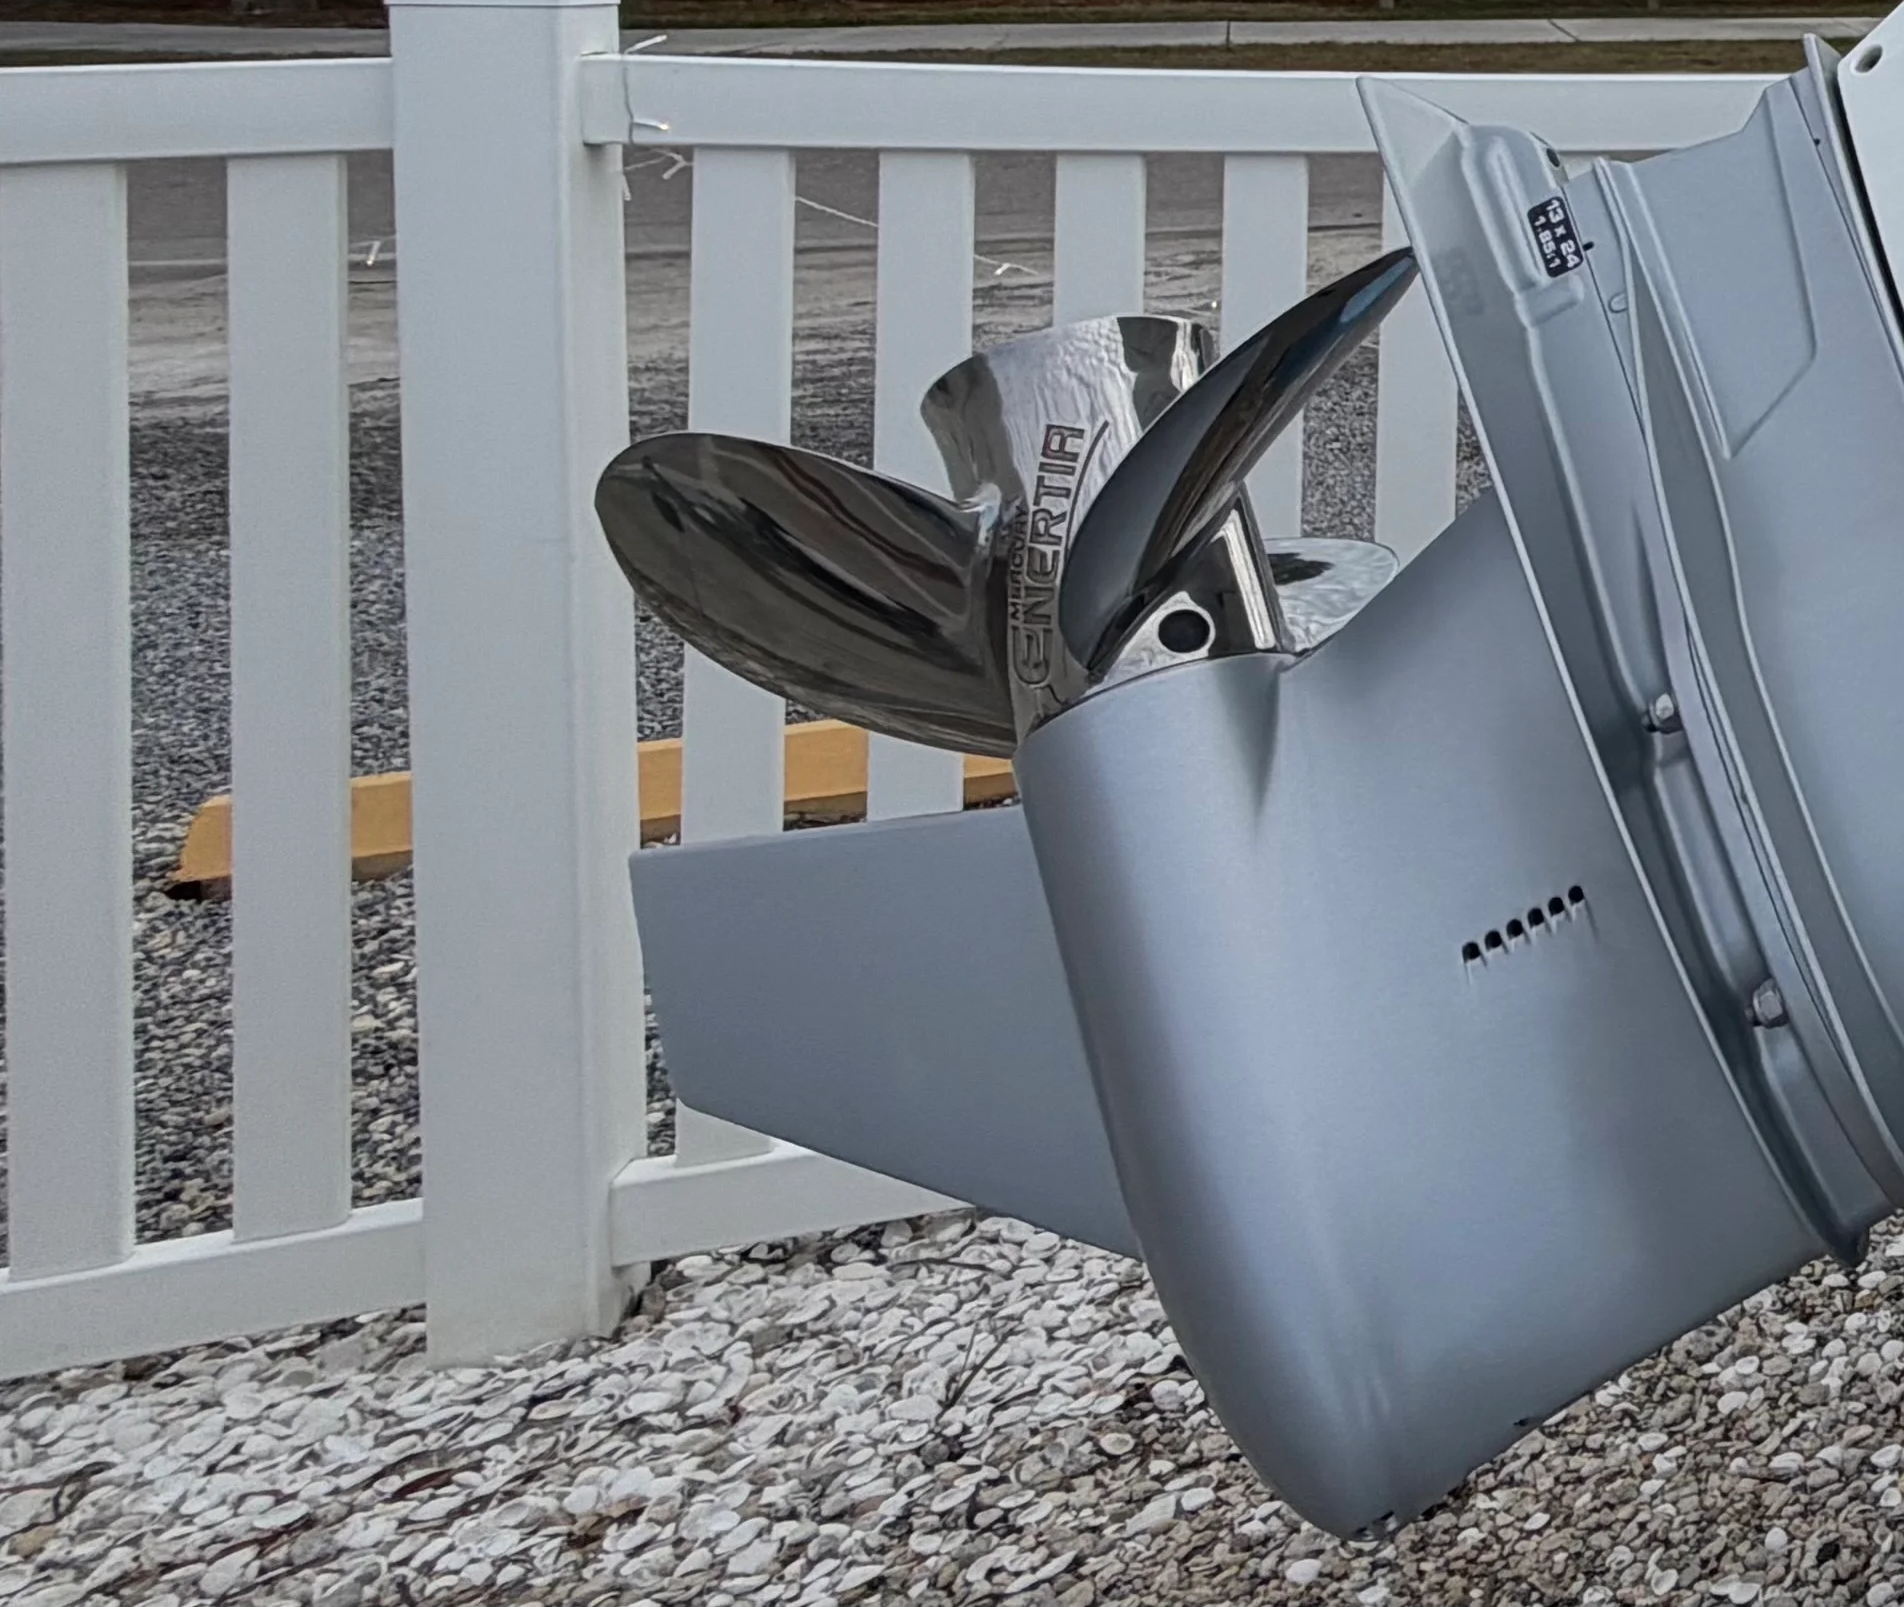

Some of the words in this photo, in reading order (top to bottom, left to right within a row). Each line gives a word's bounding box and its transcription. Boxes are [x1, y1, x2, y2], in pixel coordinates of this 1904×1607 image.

[1546, 199, 1565, 223] 13
[1560, 239, 1580, 268] 24
[1010, 423, 1086, 686] ENERTIA
